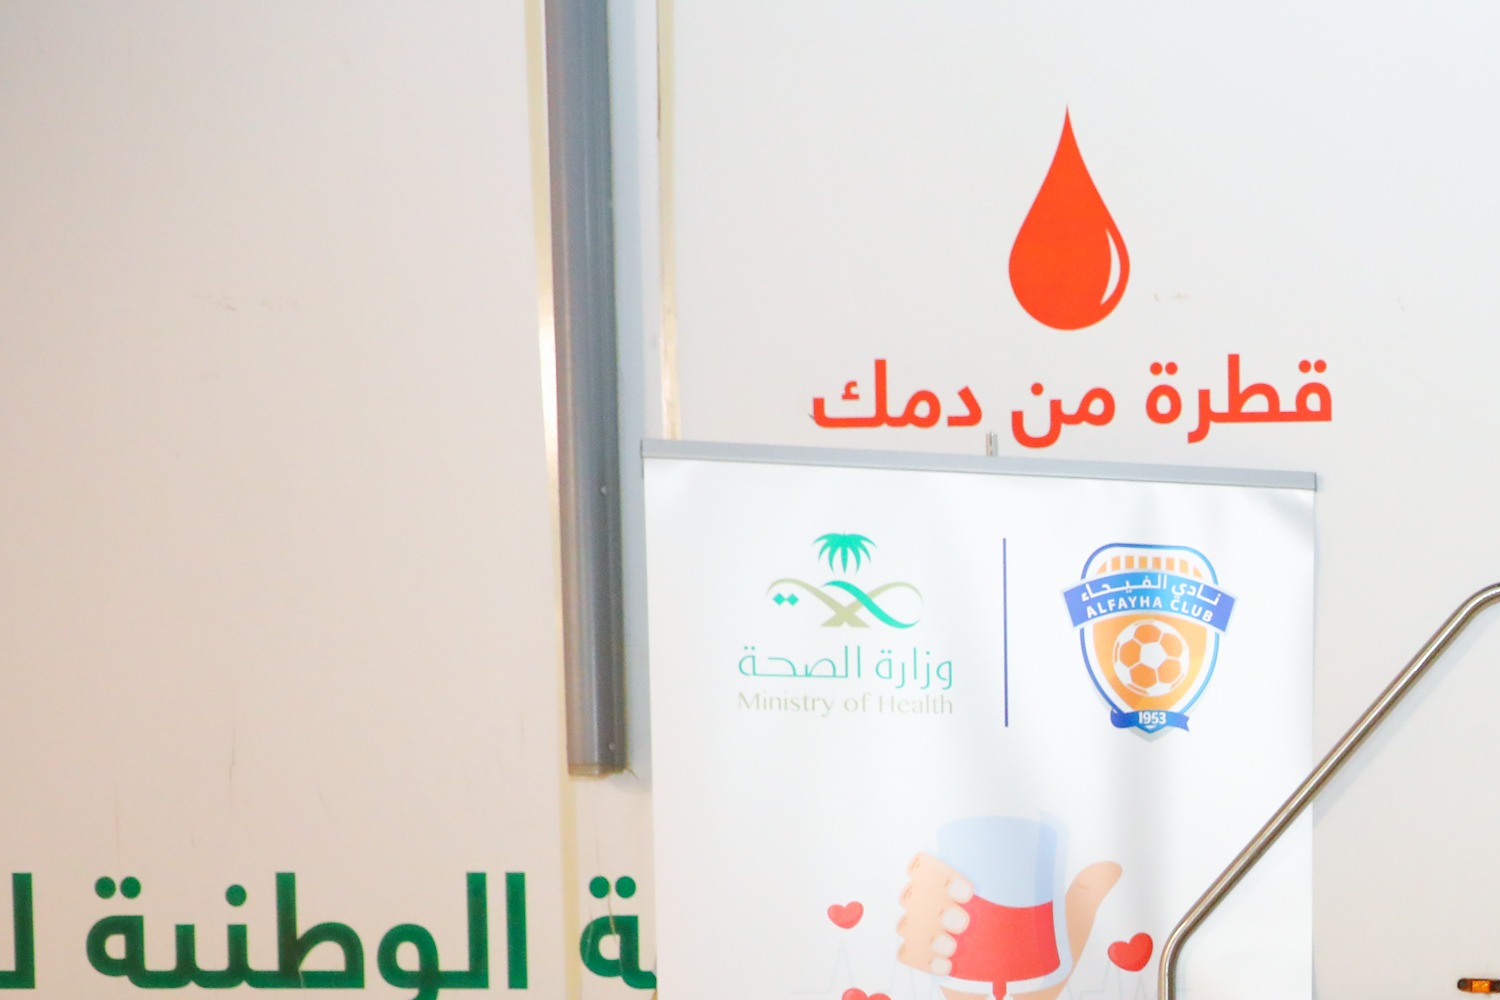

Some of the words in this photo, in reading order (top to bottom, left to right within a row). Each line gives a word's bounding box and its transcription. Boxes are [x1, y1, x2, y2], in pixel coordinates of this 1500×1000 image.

[812, 359, 983, 429] دمك
[1145, 353, 1333, 444] قطرة
[1011, 382, 1116, 449] من
[1081, 574, 1167, 602] الفيحاء
[1171, 583, 1221, 606] نادي
[1086, 596, 1163, 619] ALFAYHA
[1170, 598, 1214, 623] CLUB
[738, 645, 862, 679] الصحة
[874, 647, 953, 690] وزارة
[738, 691, 834, 717] Ministry
[843, 692, 872, 713] of
[879, 692, 953, 715] Health
[1138, 711, 1166, 725] 1953
